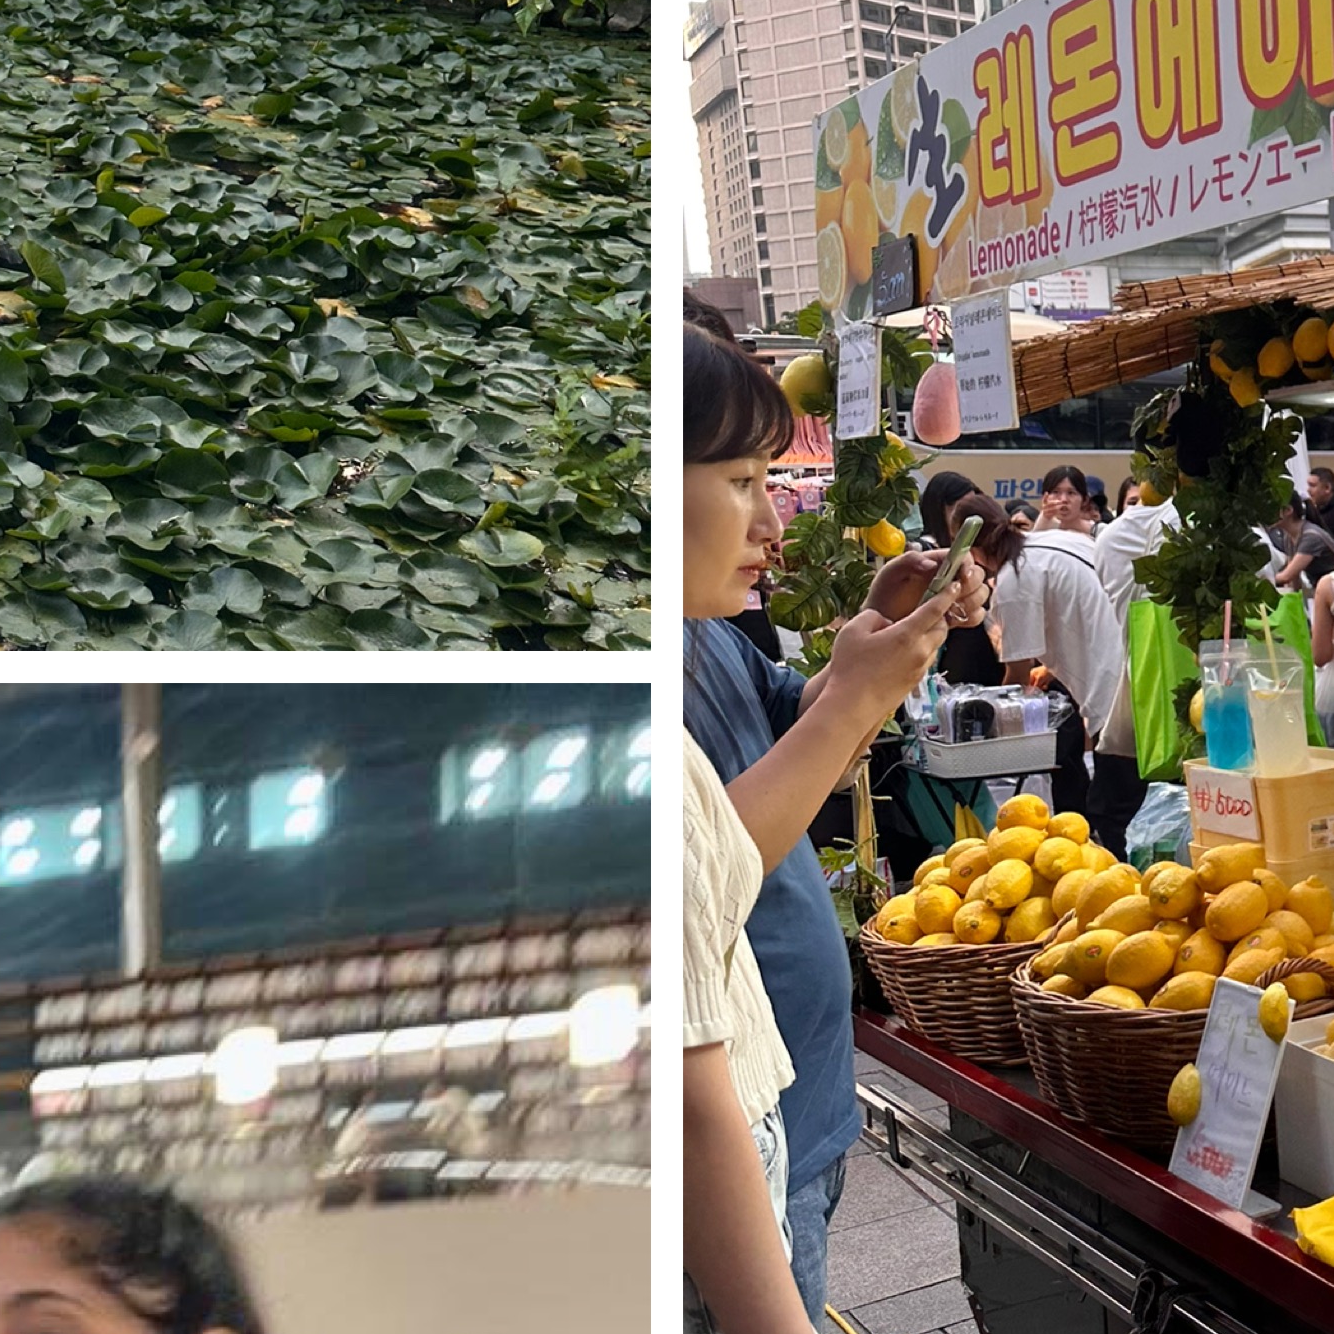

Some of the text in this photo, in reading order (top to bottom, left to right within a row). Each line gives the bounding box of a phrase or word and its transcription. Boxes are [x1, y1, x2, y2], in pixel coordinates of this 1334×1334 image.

[967, 221, 1061, 279] Lemonade
[1078, 175, 1164, 248] 柠檬汽水
